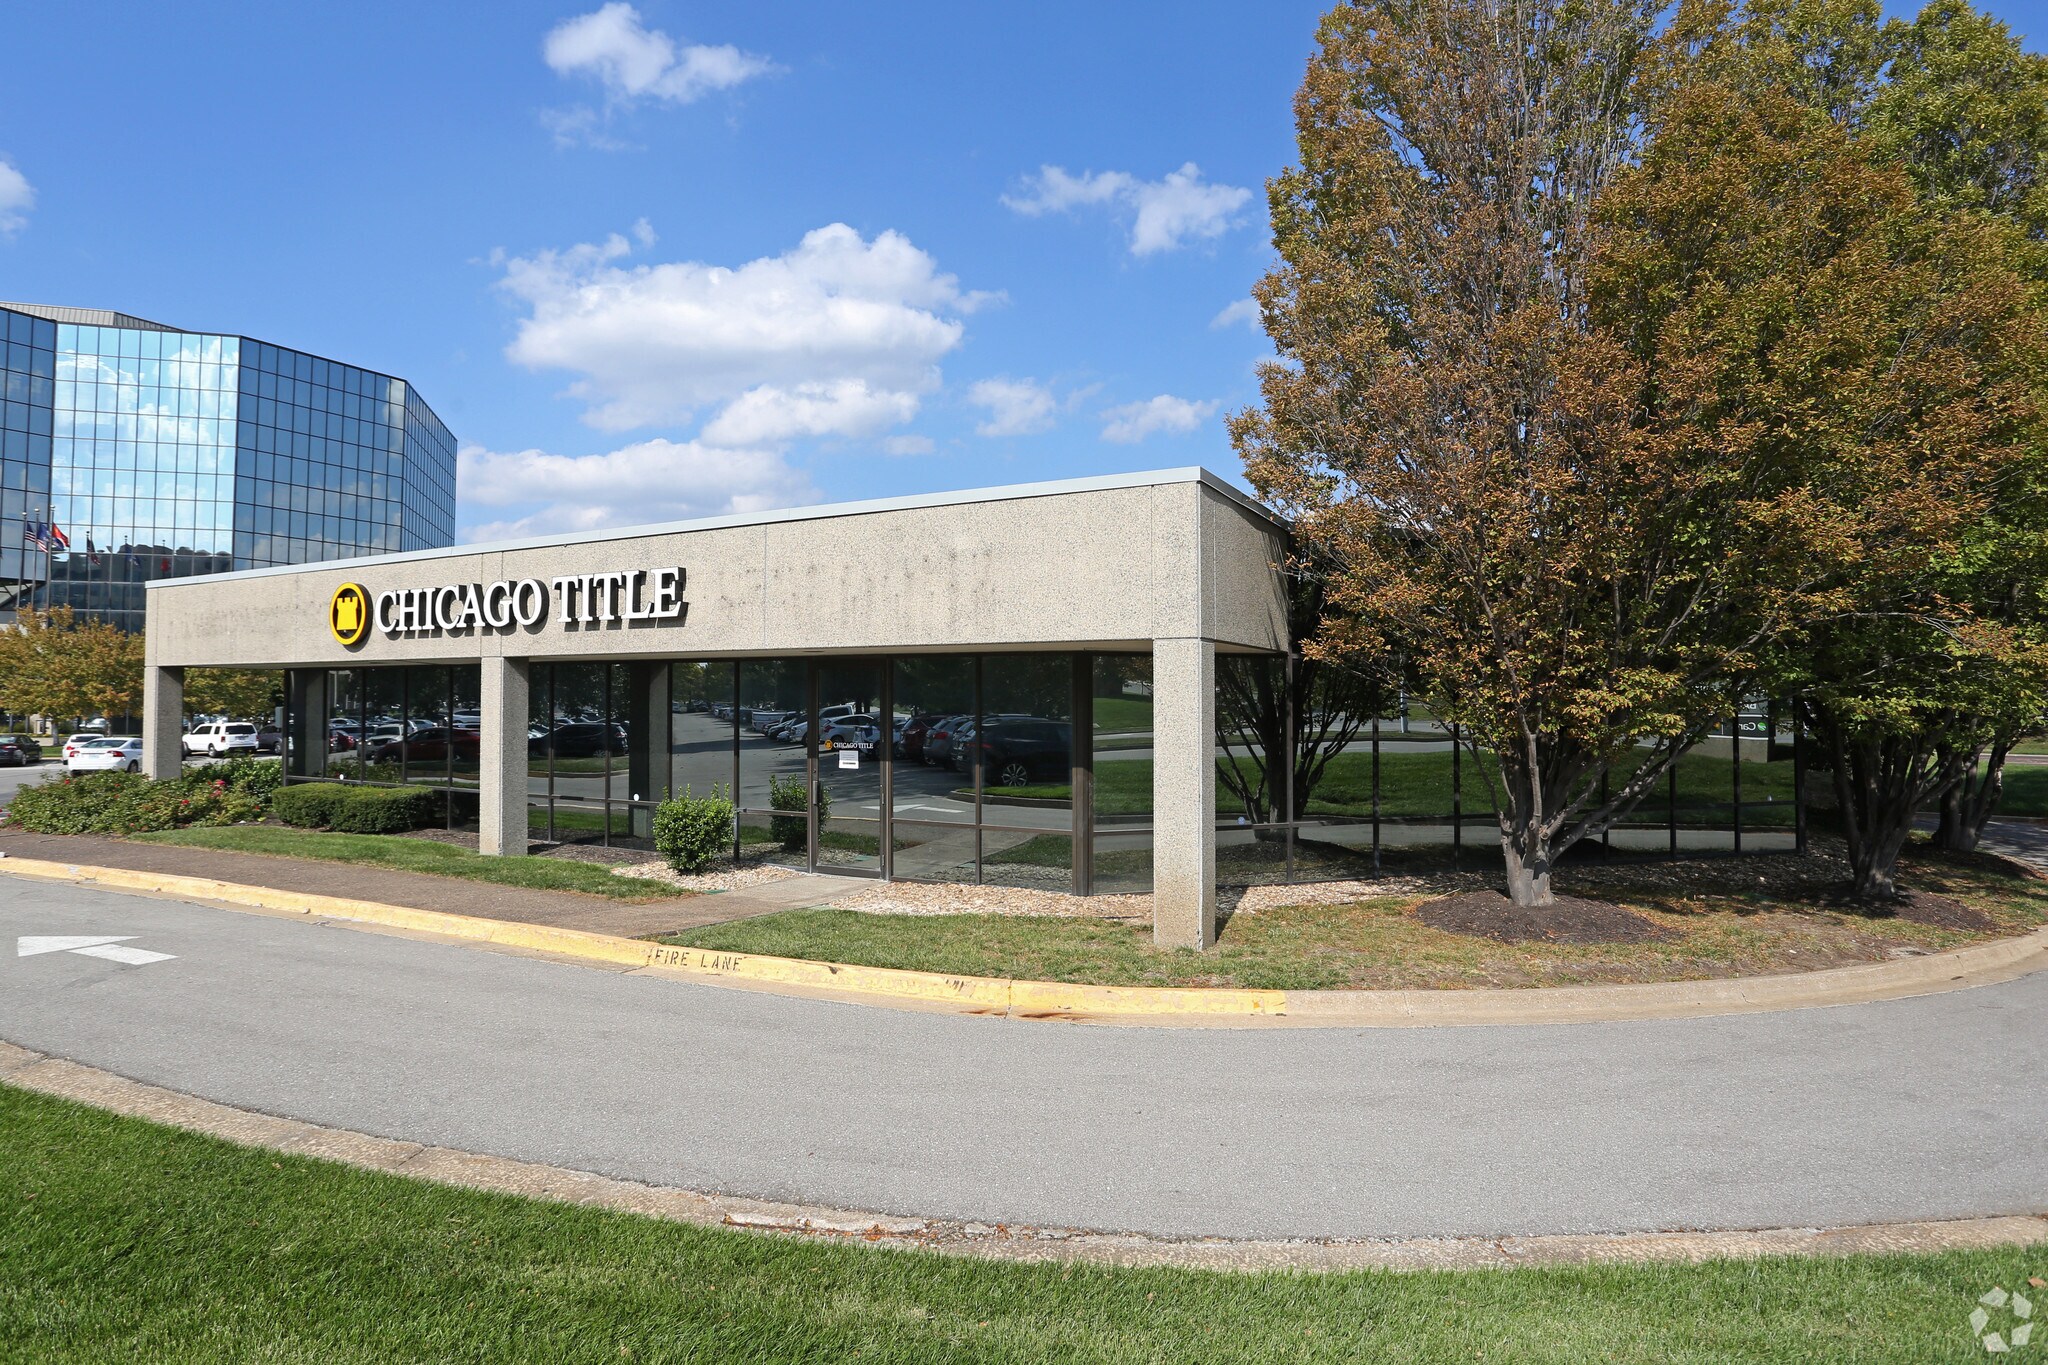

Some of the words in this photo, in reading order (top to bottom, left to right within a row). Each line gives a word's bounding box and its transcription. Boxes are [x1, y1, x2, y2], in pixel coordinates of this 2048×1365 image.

[374, 578, 545, 633] CHICAGO
[552, 567, 686, 624] TITLE
[655, 948, 690, 967] FIRE
[700, 953, 743, 972] LANE
